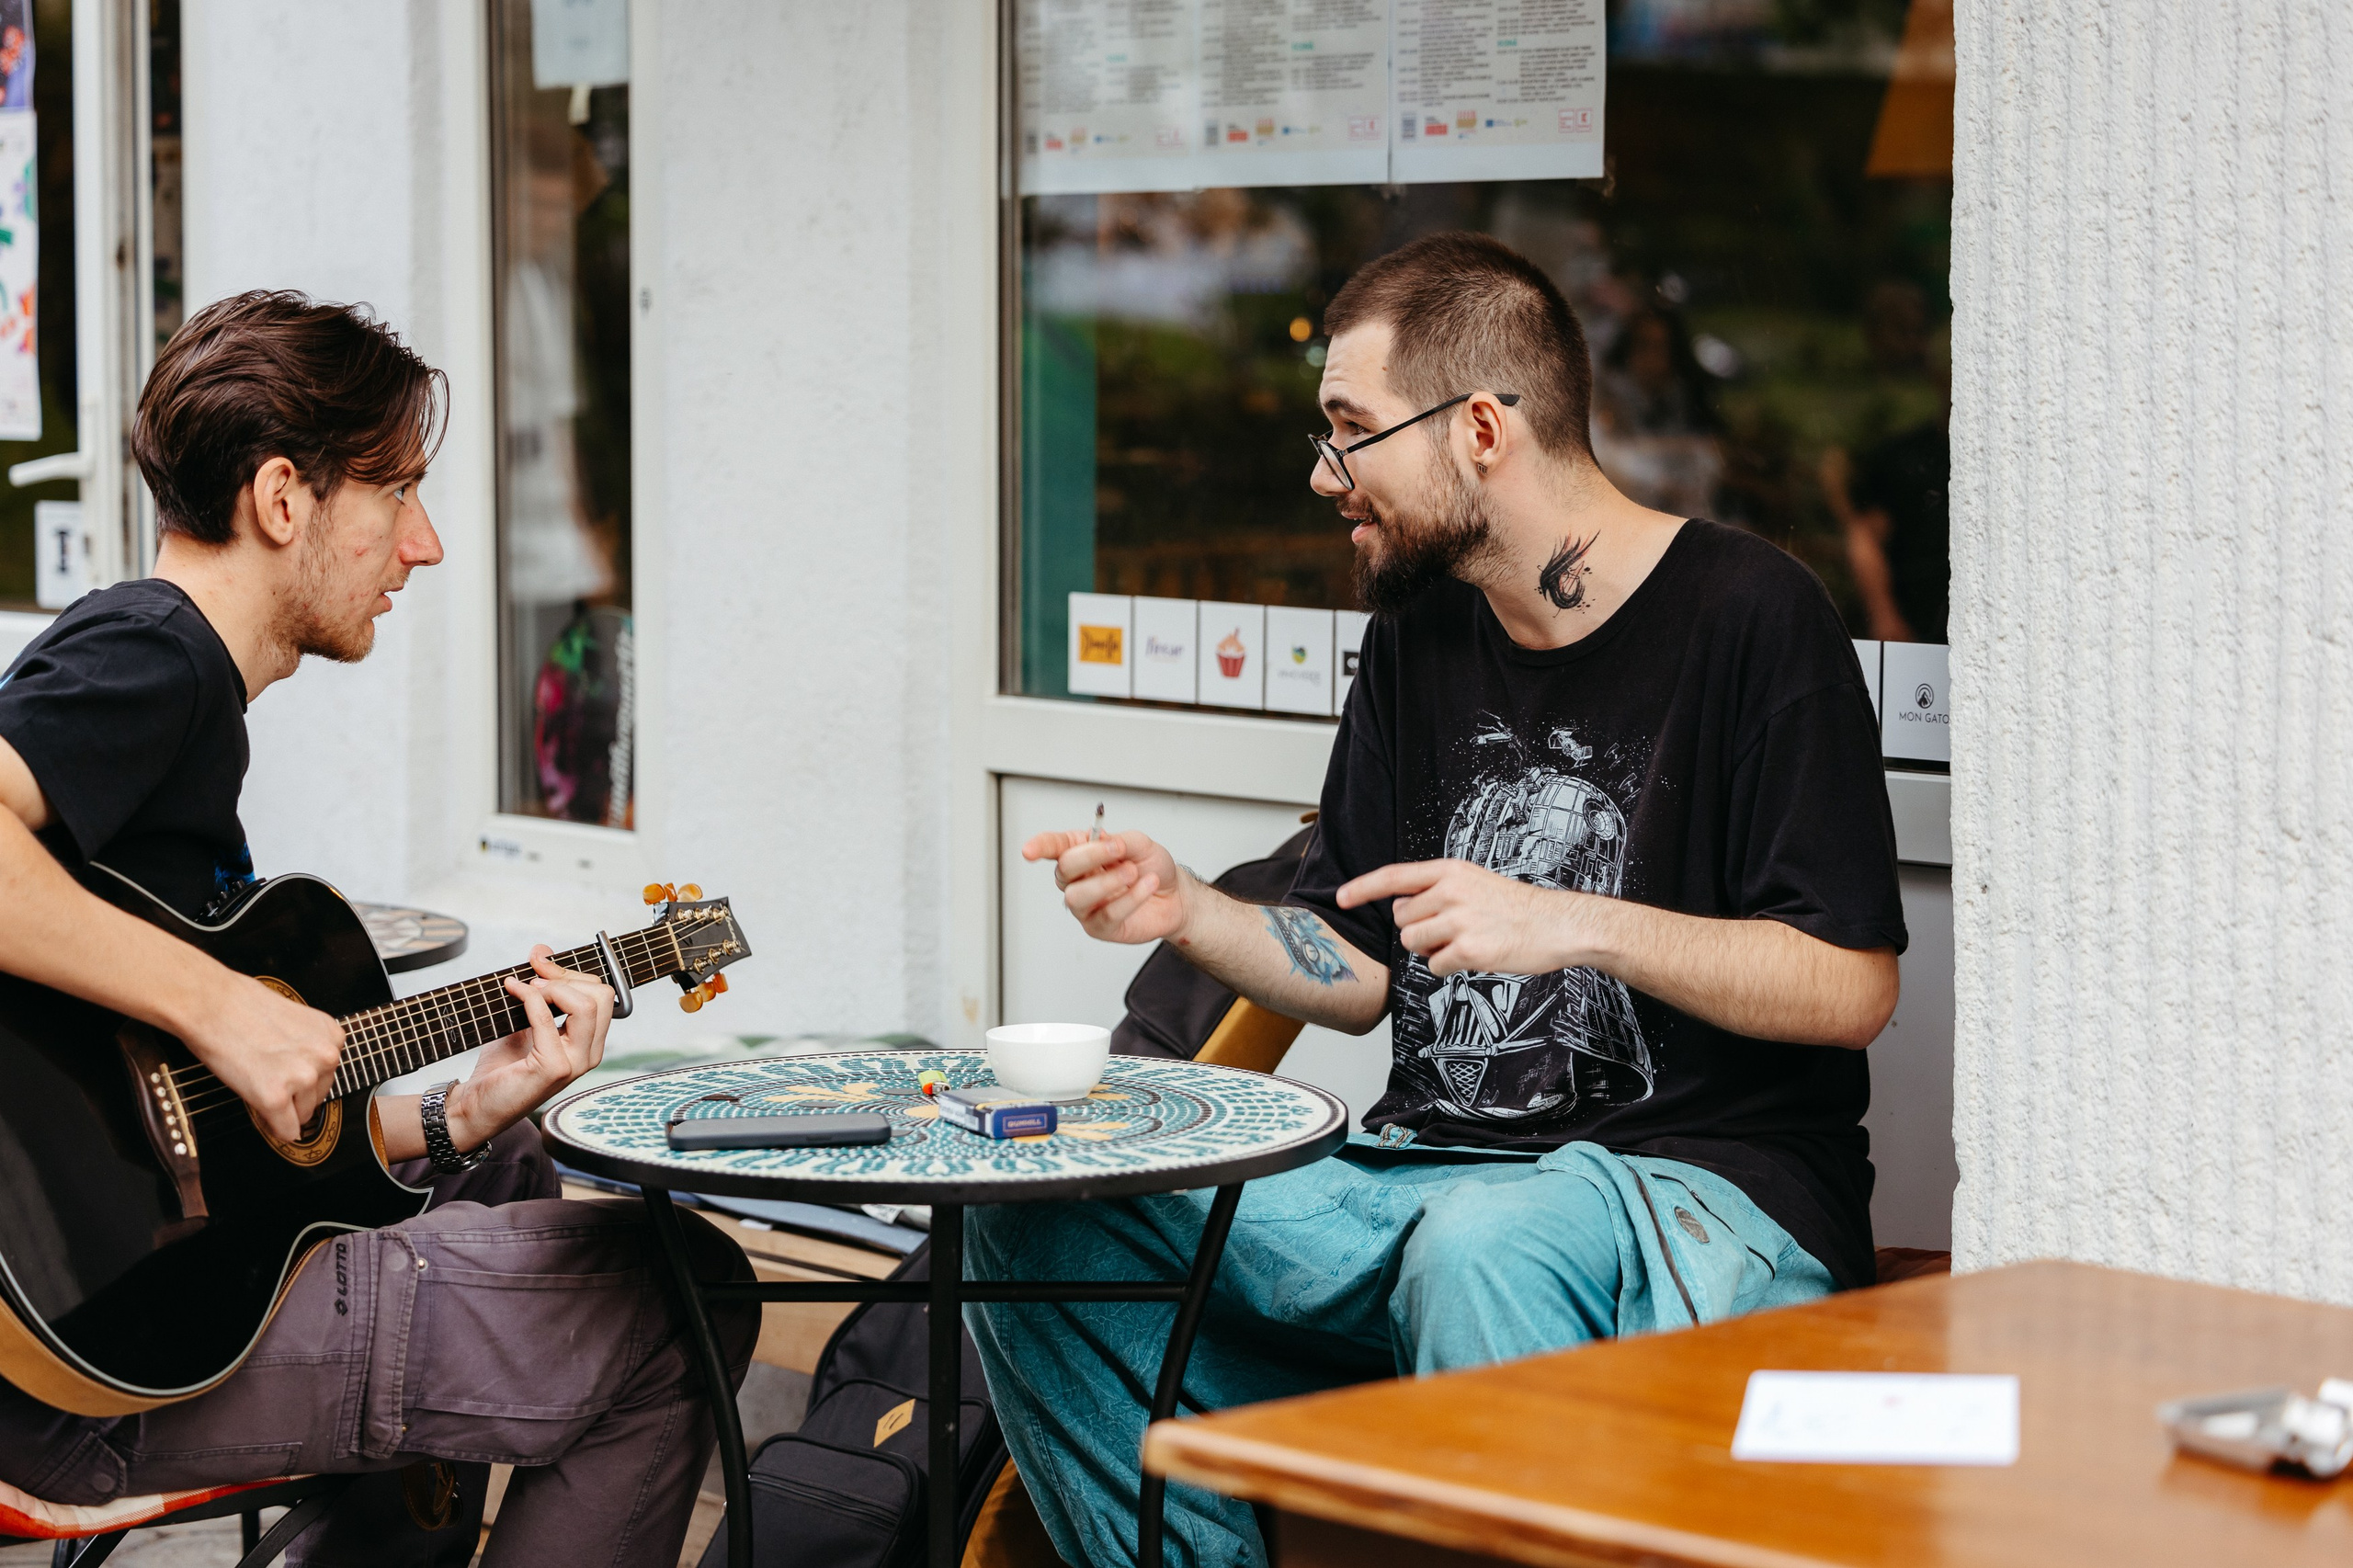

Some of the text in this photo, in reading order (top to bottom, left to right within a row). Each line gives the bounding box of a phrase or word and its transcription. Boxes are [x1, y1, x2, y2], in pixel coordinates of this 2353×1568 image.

[1898, 711, 1949, 724] MON GATO
[335, 1243, 348, 1297] LOTTO
